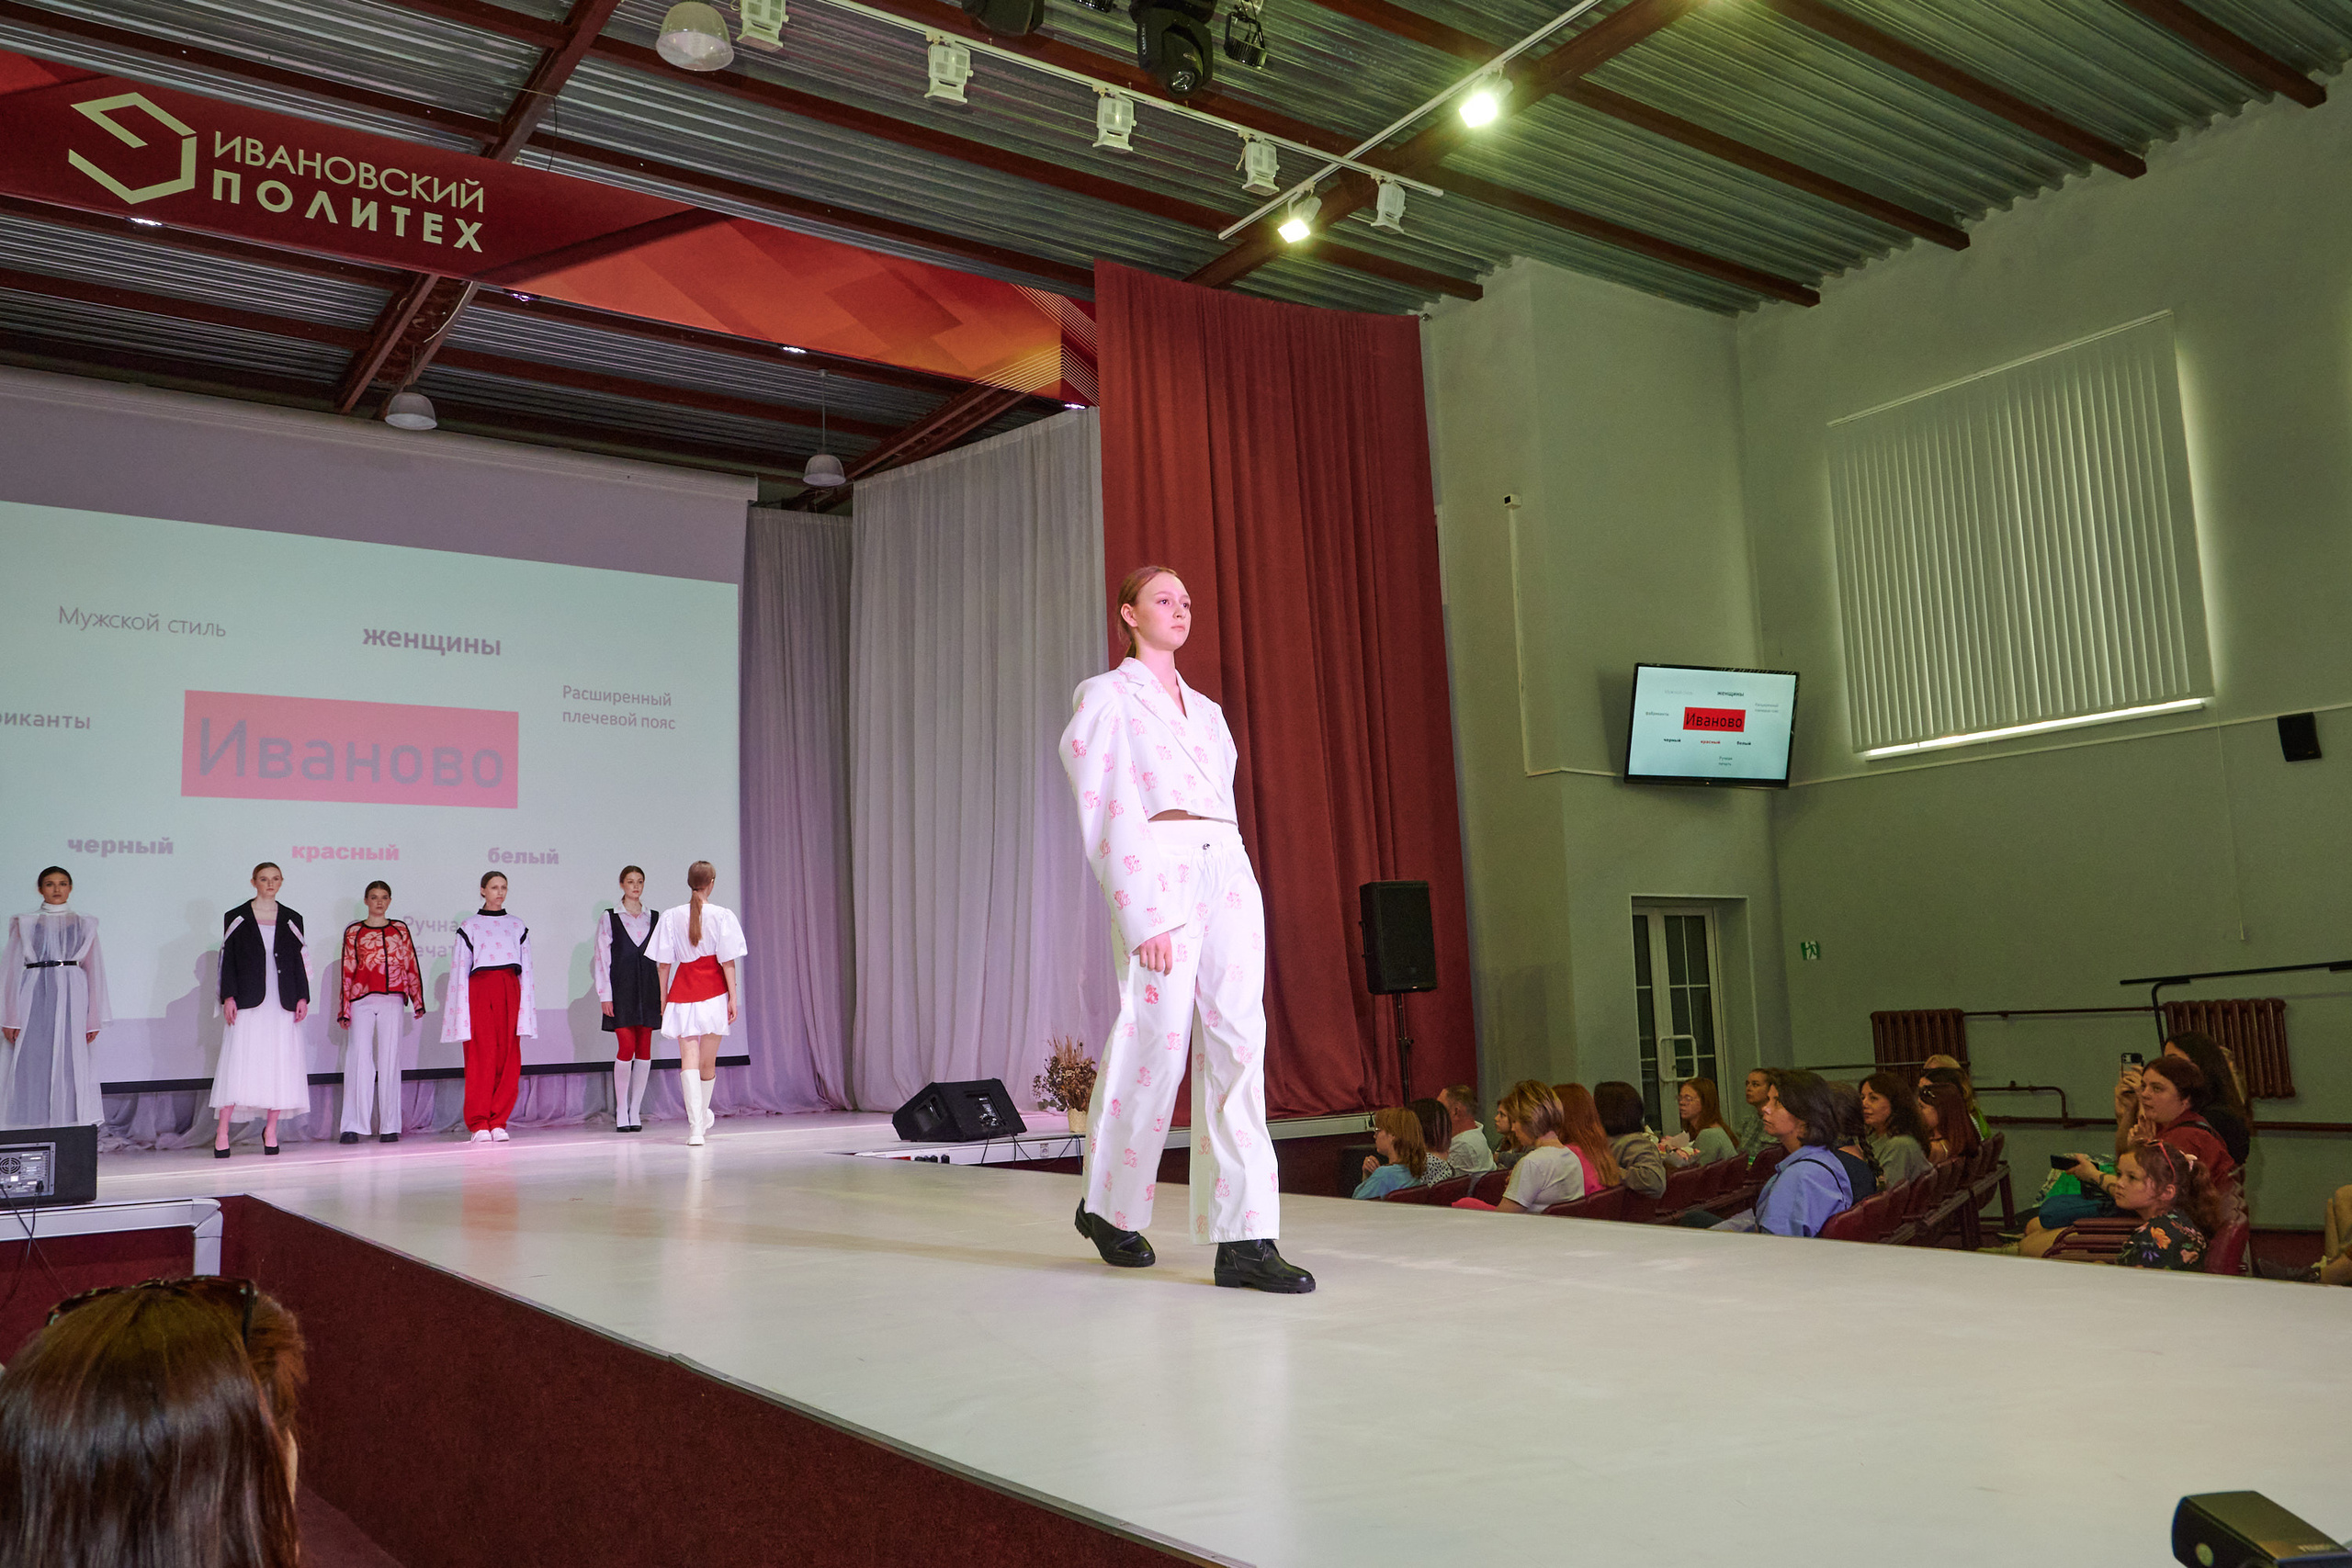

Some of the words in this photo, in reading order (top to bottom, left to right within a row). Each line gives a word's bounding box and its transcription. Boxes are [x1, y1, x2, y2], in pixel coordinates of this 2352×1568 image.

[214, 130, 484, 213] ИВАНОВСКИЙ
[212, 169, 483, 253] ПОЛИТЕХ
[58, 605, 160, 632] Мужской
[167, 619, 227, 637] стиль
[363, 628, 502, 657] женщины
[562, 684, 672, 706] Расширенный
[0, 712, 91, 729] иканты
[562, 711, 637, 728] плечевой
[640, 716, 676, 730] пояс
[1685, 713, 1743, 728] Иваново
[198, 717, 504, 789] Иваново
[67, 837, 175, 858] черный
[291, 844, 401, 863] красный
[487, 847, 560, 864] белый
[403, 916, 460, 936] Ручна
[415, 944, 455, 958] ечат
